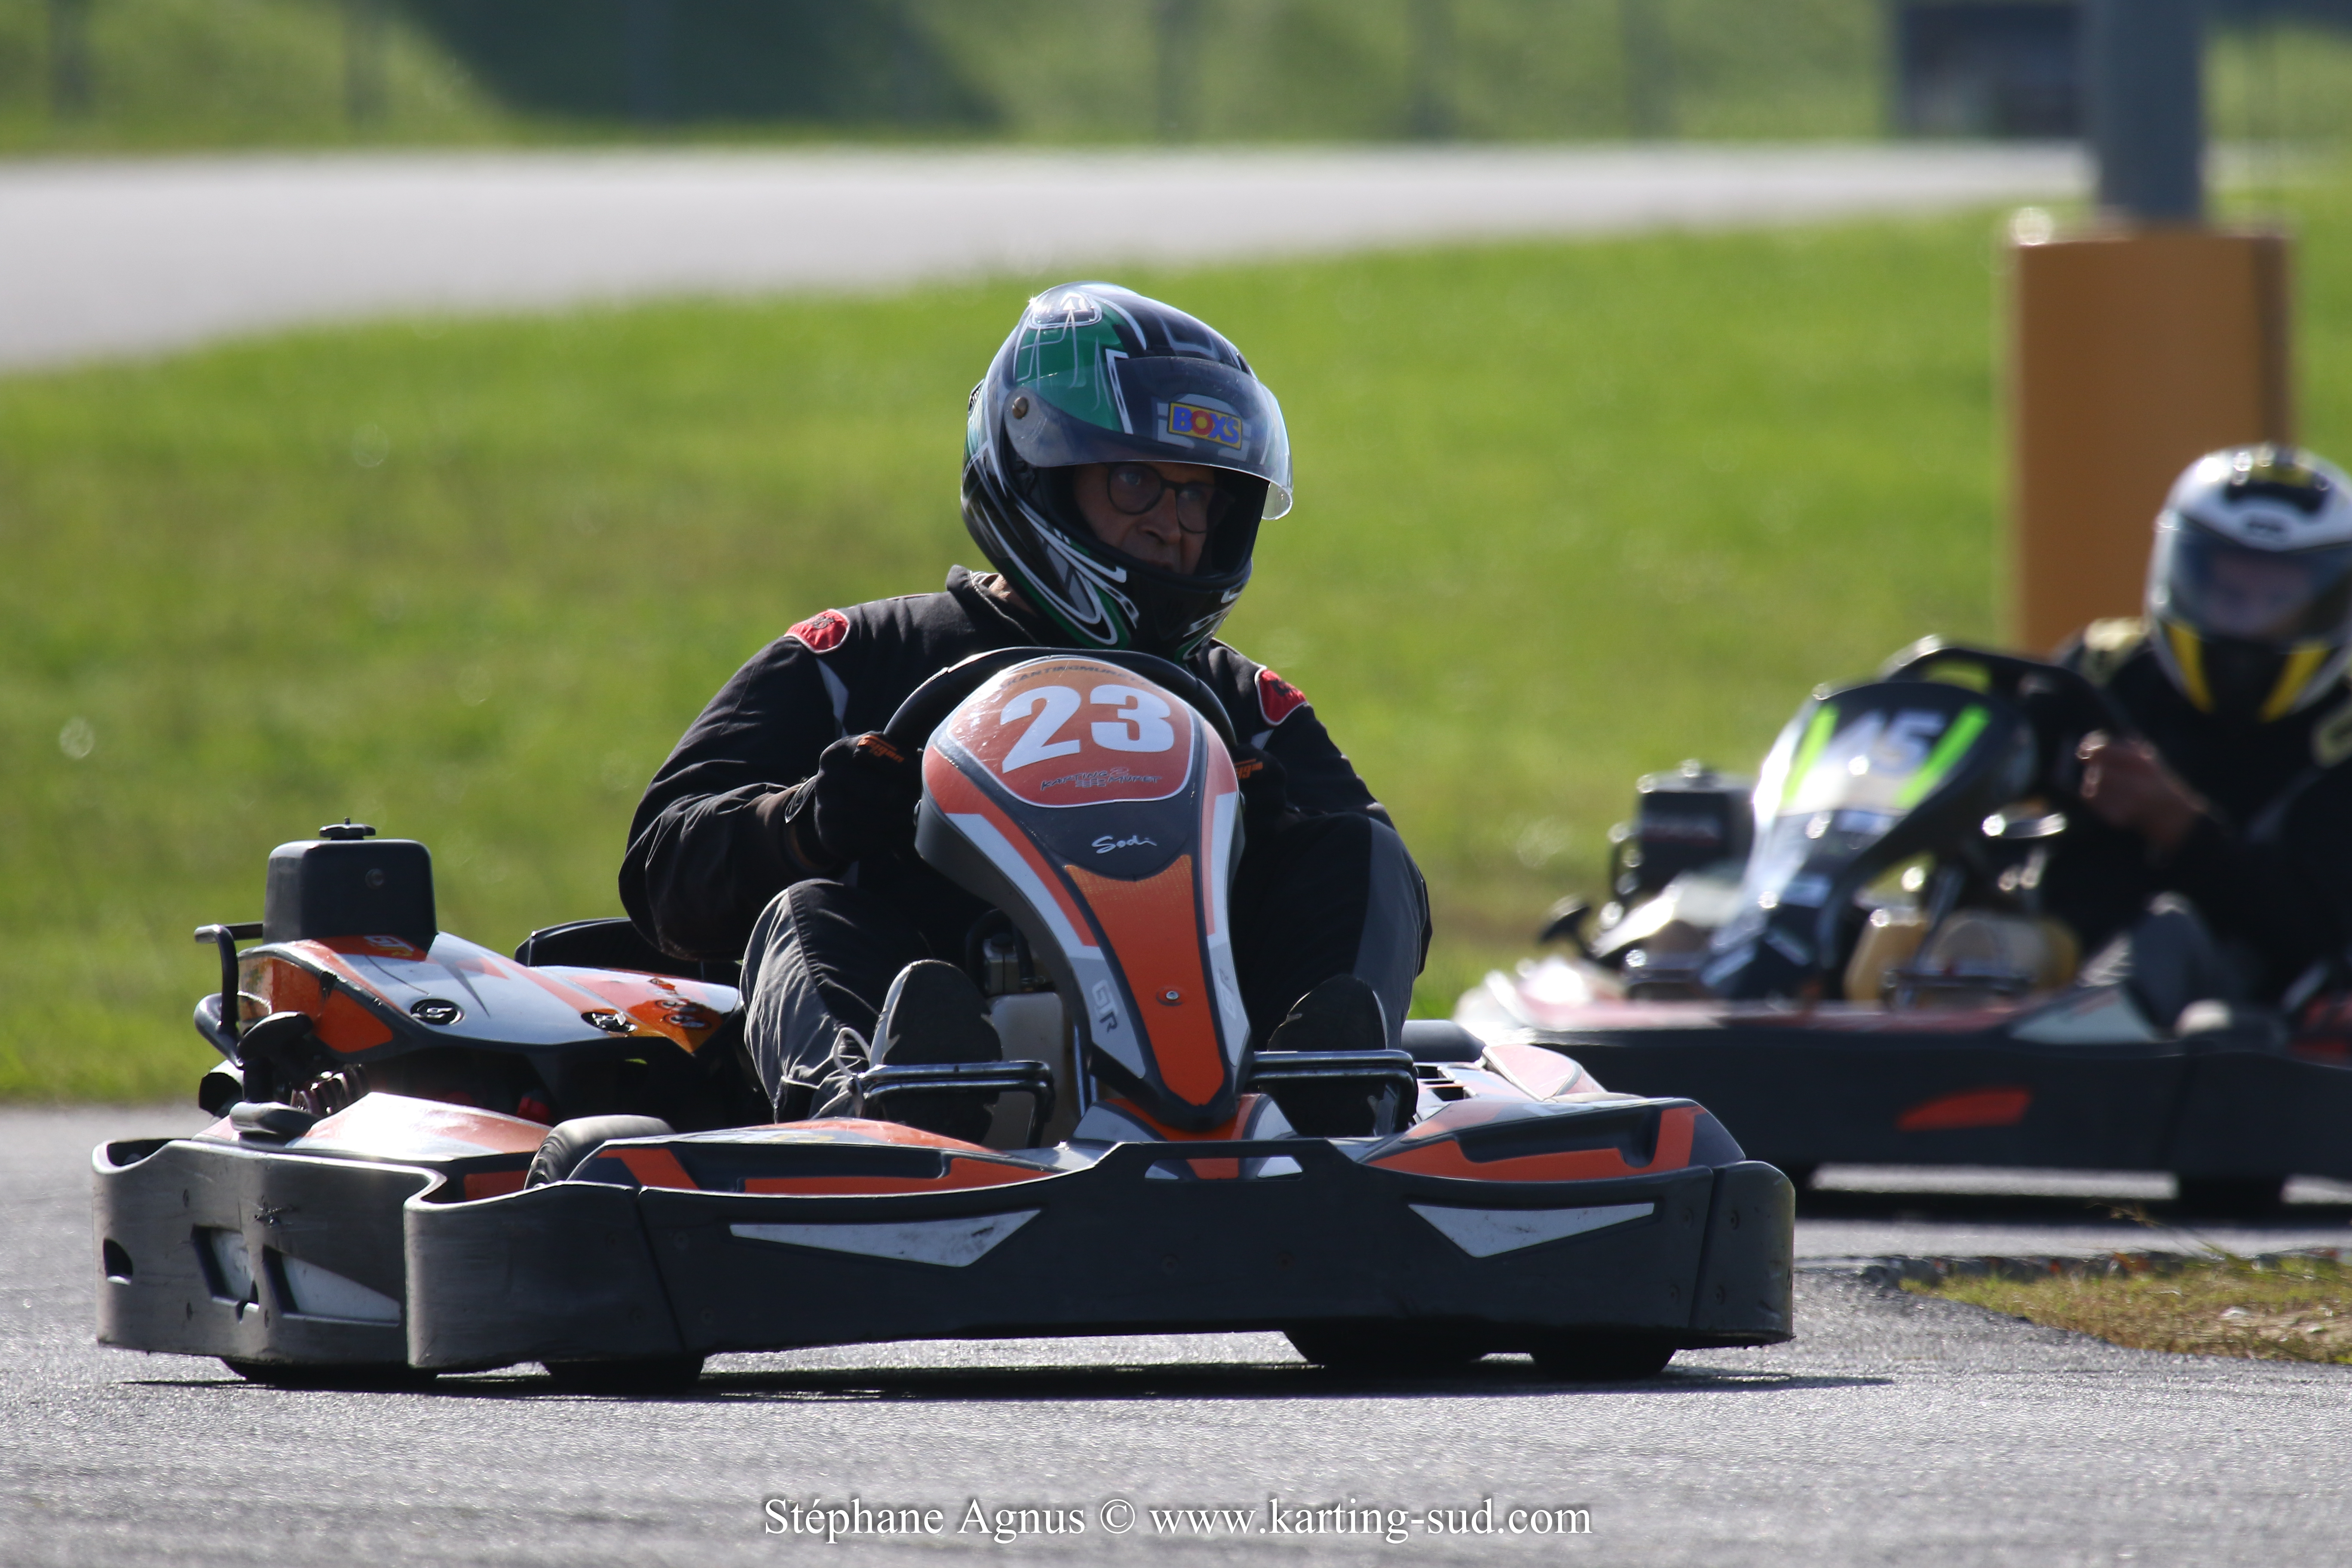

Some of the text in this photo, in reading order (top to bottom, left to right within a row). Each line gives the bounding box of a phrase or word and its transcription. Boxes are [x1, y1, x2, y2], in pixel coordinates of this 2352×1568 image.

[1000, 685, 1174, 773] 23
[1040, 770, 1162, 791] KARTING MURET
[1091, 835, 1157, 854] Sodi
[1092, 979, 1118, 1032] GTR
